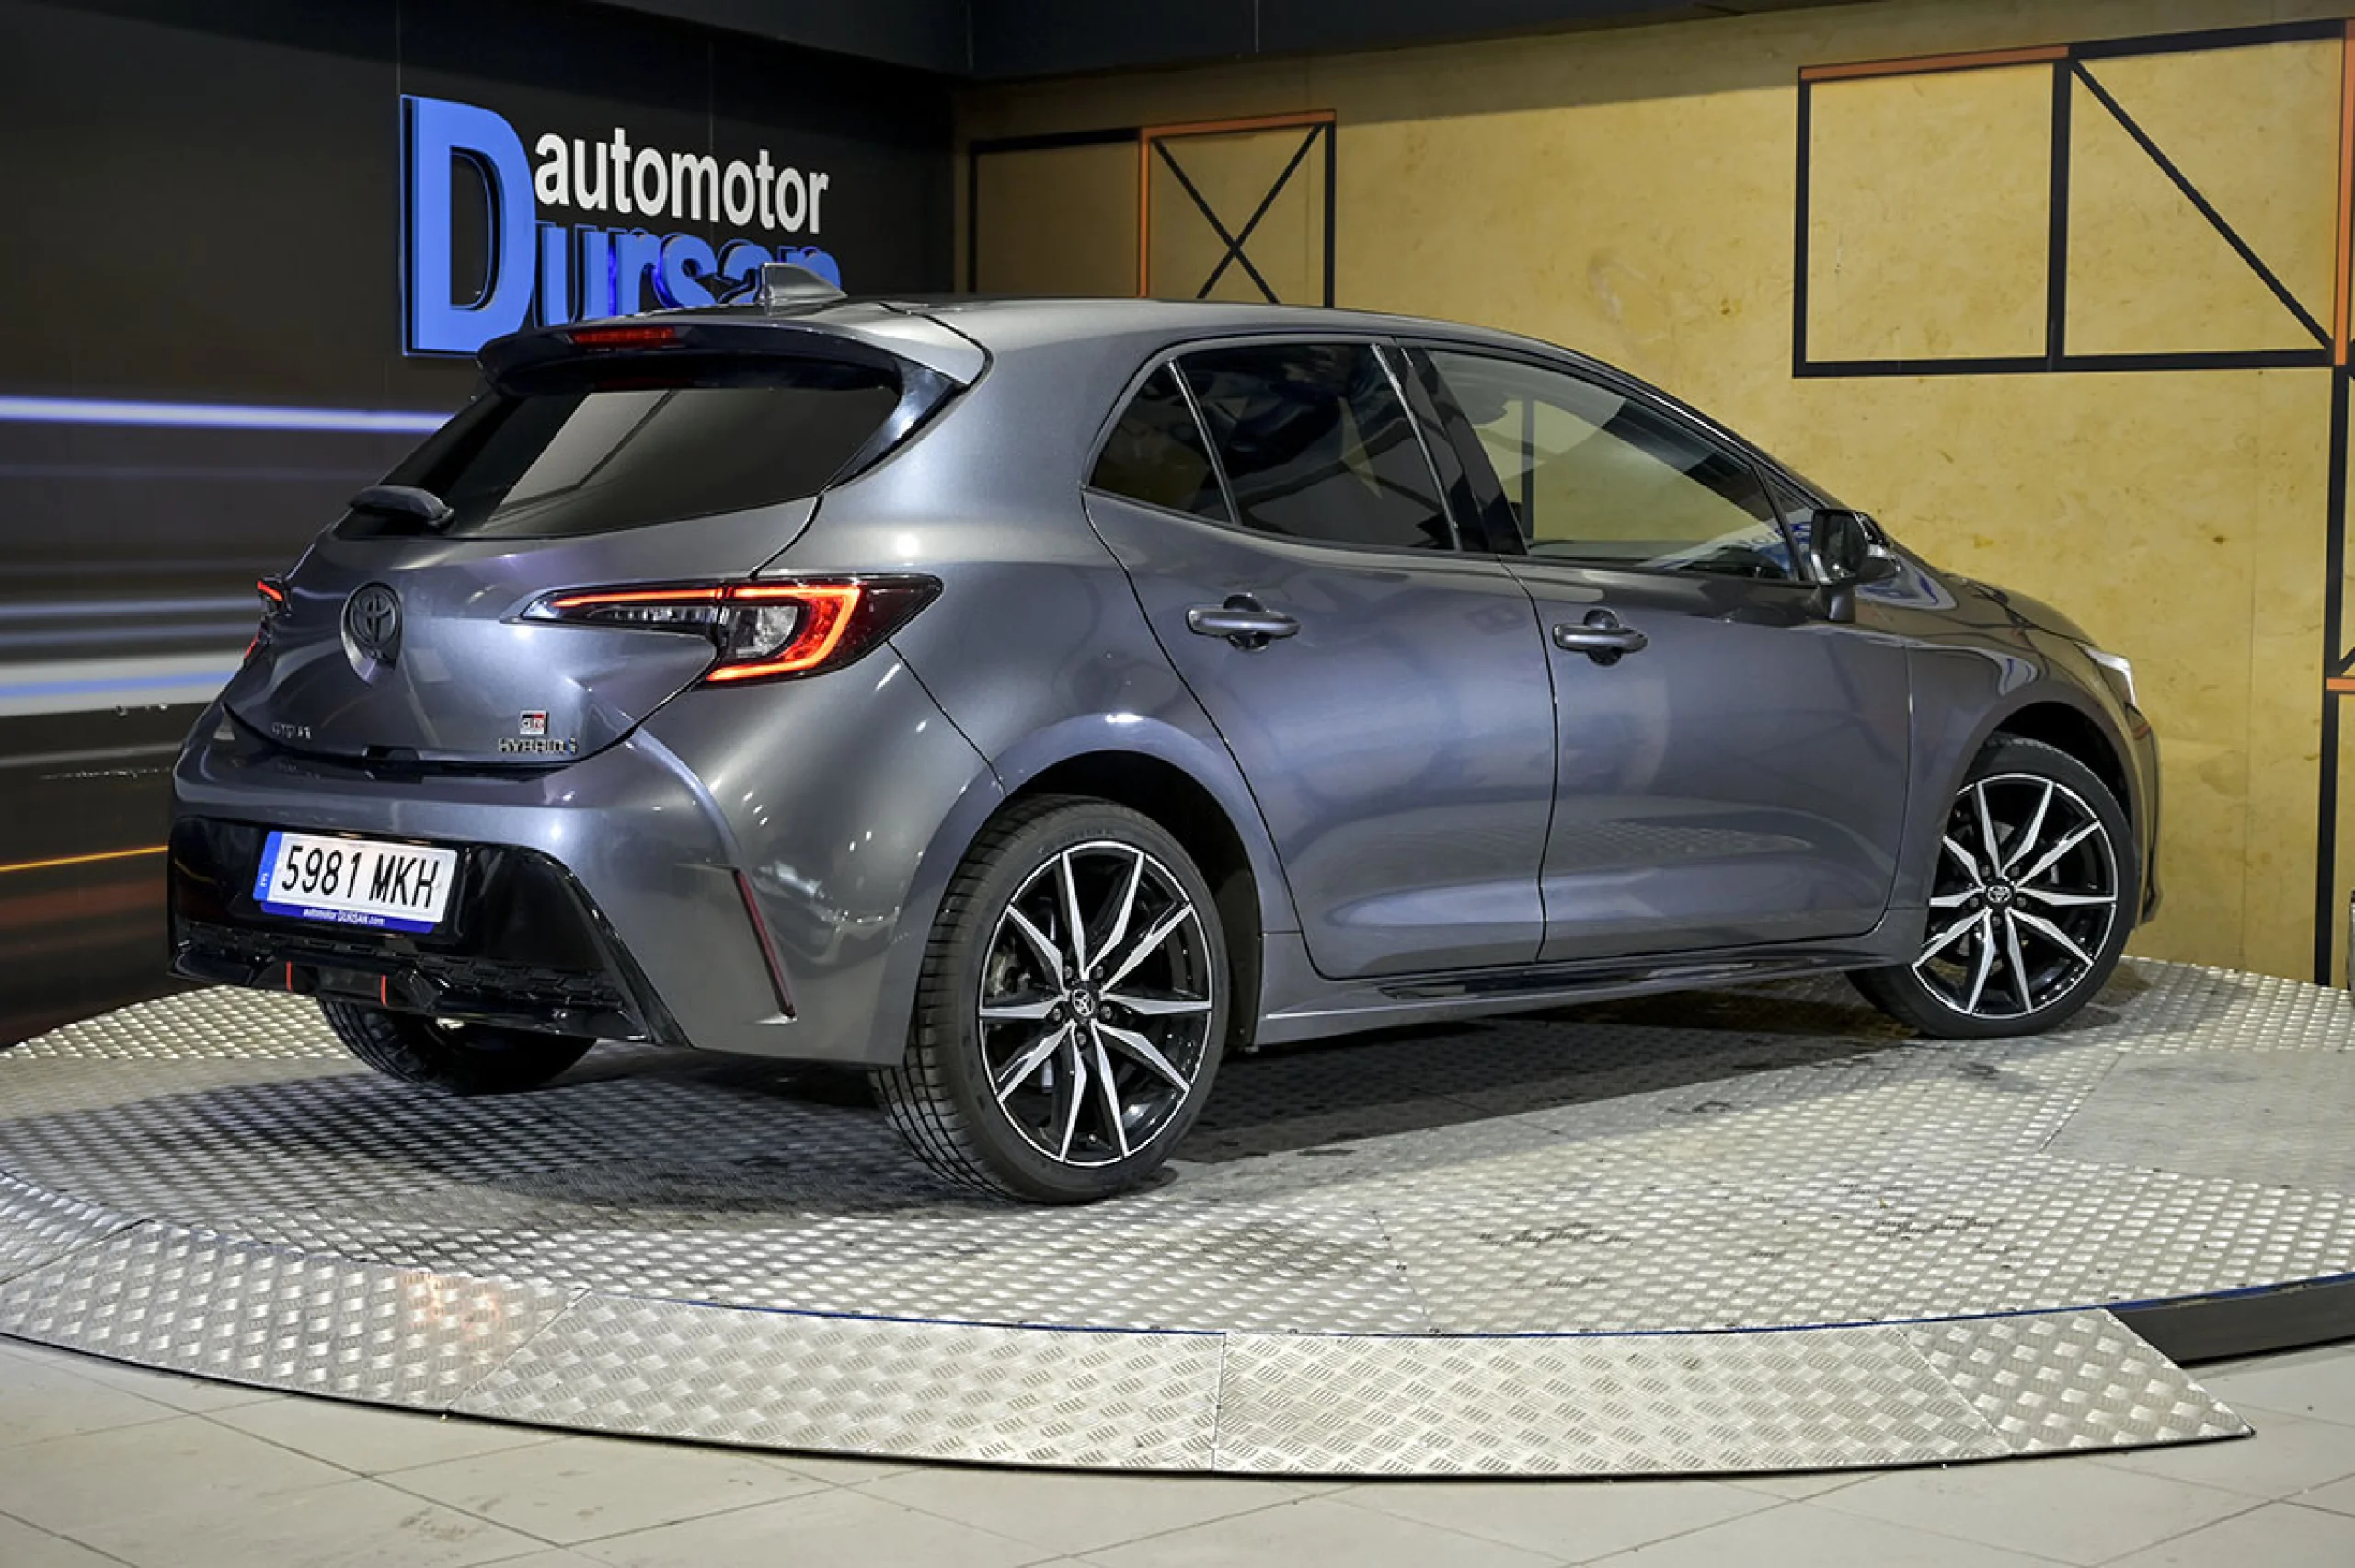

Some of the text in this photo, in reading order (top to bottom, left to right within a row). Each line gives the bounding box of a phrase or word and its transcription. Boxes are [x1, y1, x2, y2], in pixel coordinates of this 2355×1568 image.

[401, 94, 841, 357] Dursa
[534, 127, 829, 234] automotor
[281, 845, 440, 909] 5981 MKH
